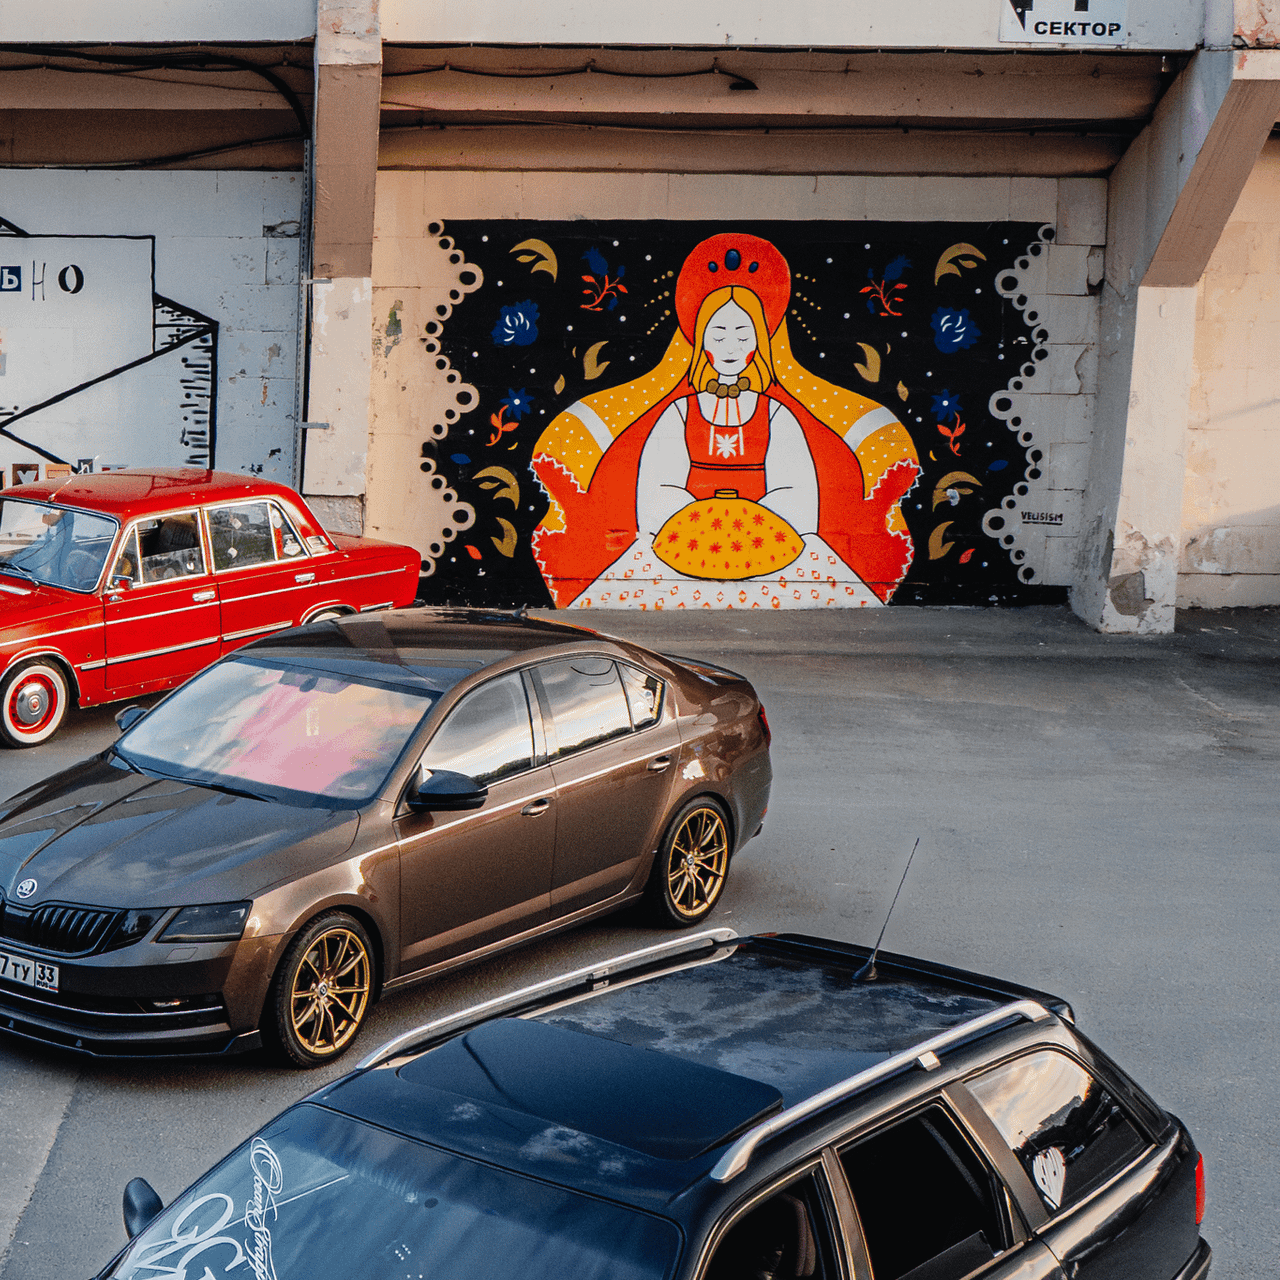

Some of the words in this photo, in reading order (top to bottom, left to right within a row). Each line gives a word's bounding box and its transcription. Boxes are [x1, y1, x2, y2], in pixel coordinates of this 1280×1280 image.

[1034, 21, 1121, 37] СЕКТОР
[1021, 511, 1063, 522] VELISISM
[37, 964, 55, 983] 33
